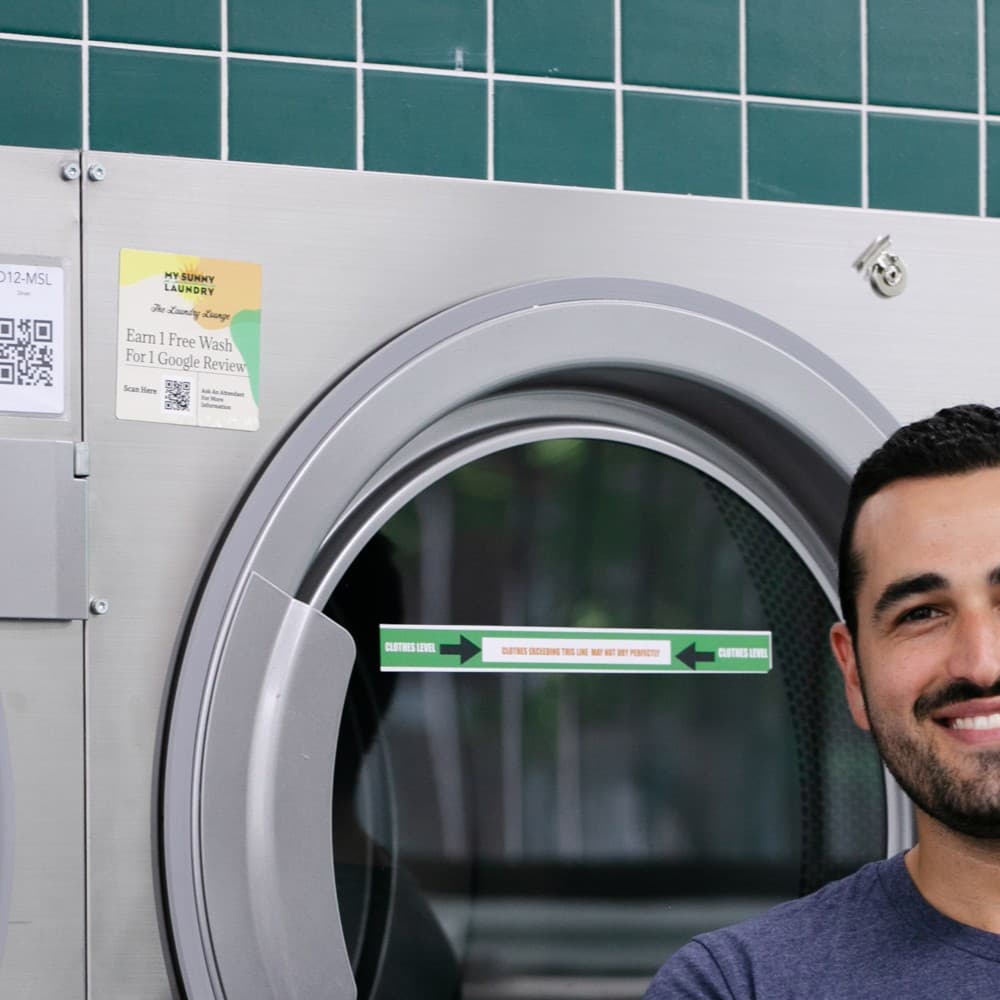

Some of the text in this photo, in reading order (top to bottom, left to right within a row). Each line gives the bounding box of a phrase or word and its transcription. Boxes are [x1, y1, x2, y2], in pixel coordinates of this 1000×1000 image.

[164, 271, 215, 283] MY SUNNY
[164, 283, 215, 296] LAUNDRY
[202, 309, 231, 322] Lounge
[126, 328, 156, 345] Earn
[169, 332, 196, 349] Free
[198, 335, 233, 353] Wash
[125, 348, 146, 363] For
[158, 351, 200, 371] Google
[203, 355, 247, 373] Review
[123, 385, 157, 394] Scan Here
